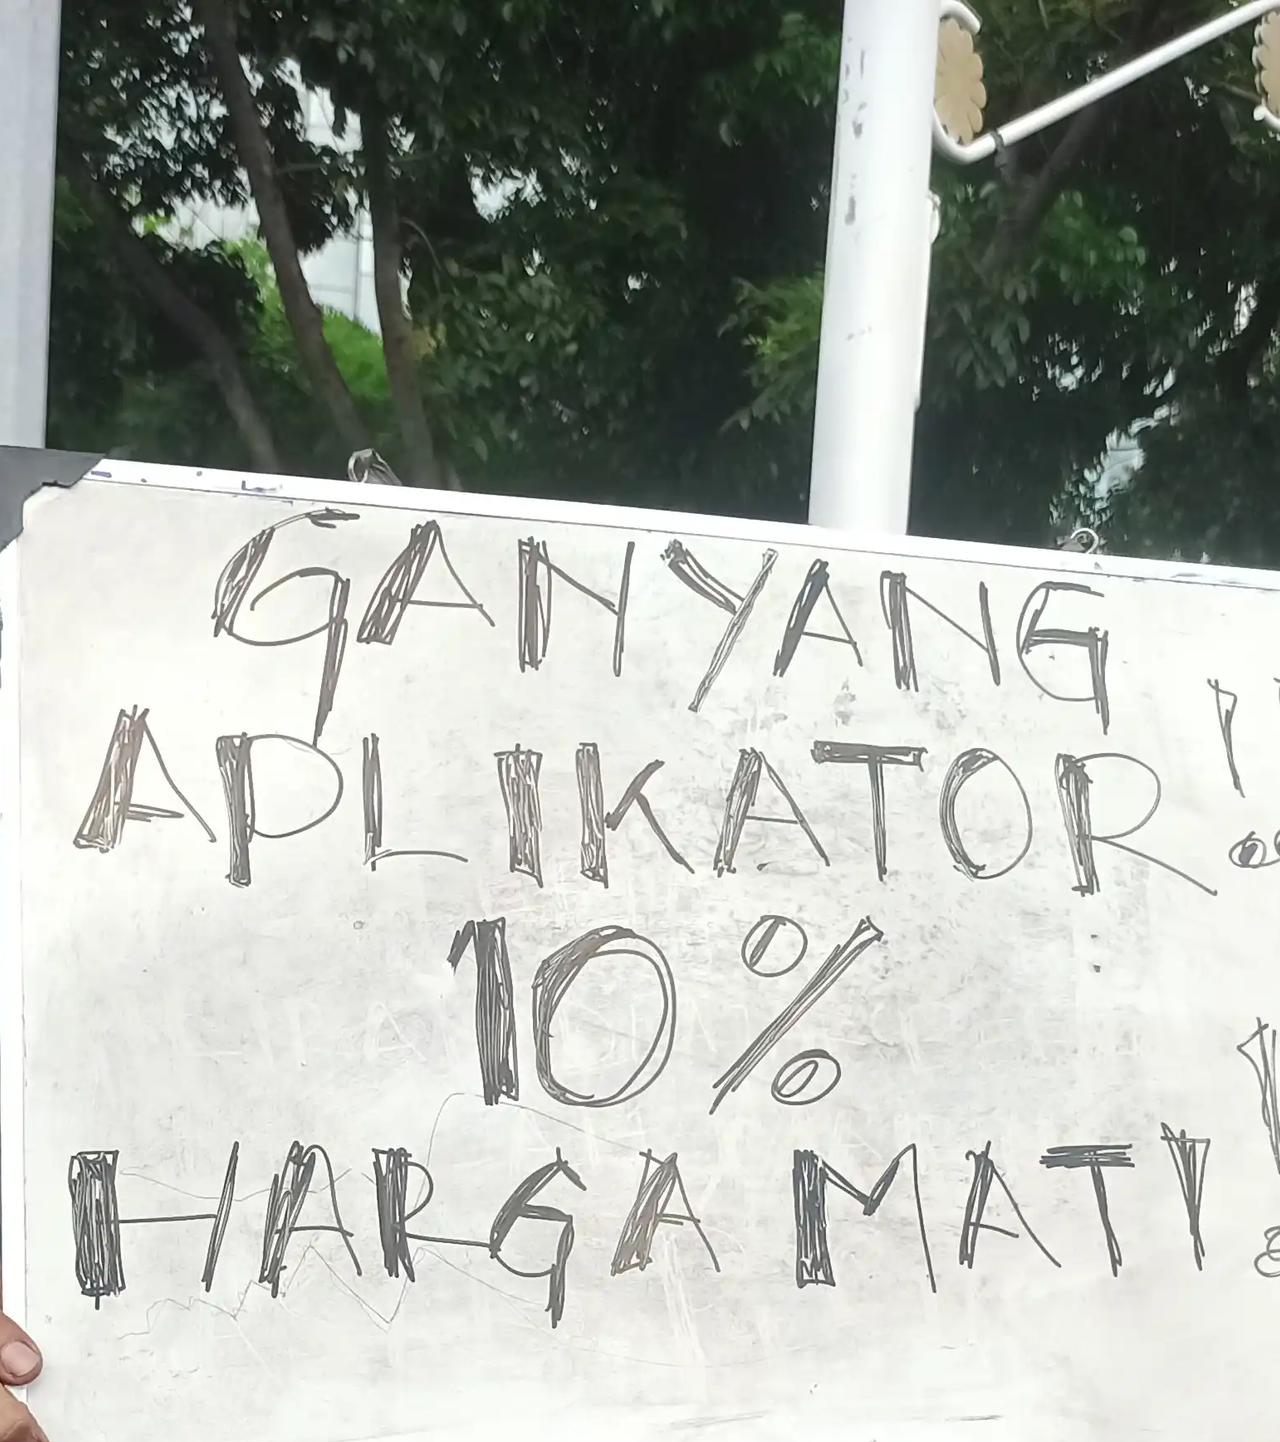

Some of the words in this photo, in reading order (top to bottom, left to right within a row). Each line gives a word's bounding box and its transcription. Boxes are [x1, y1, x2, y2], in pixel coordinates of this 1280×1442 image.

[213, 507, 1110, 747] GANYANG
[73, 704, 1218, 897] APLIKATOR
[68, 1141, 721, 1328] HARGA
